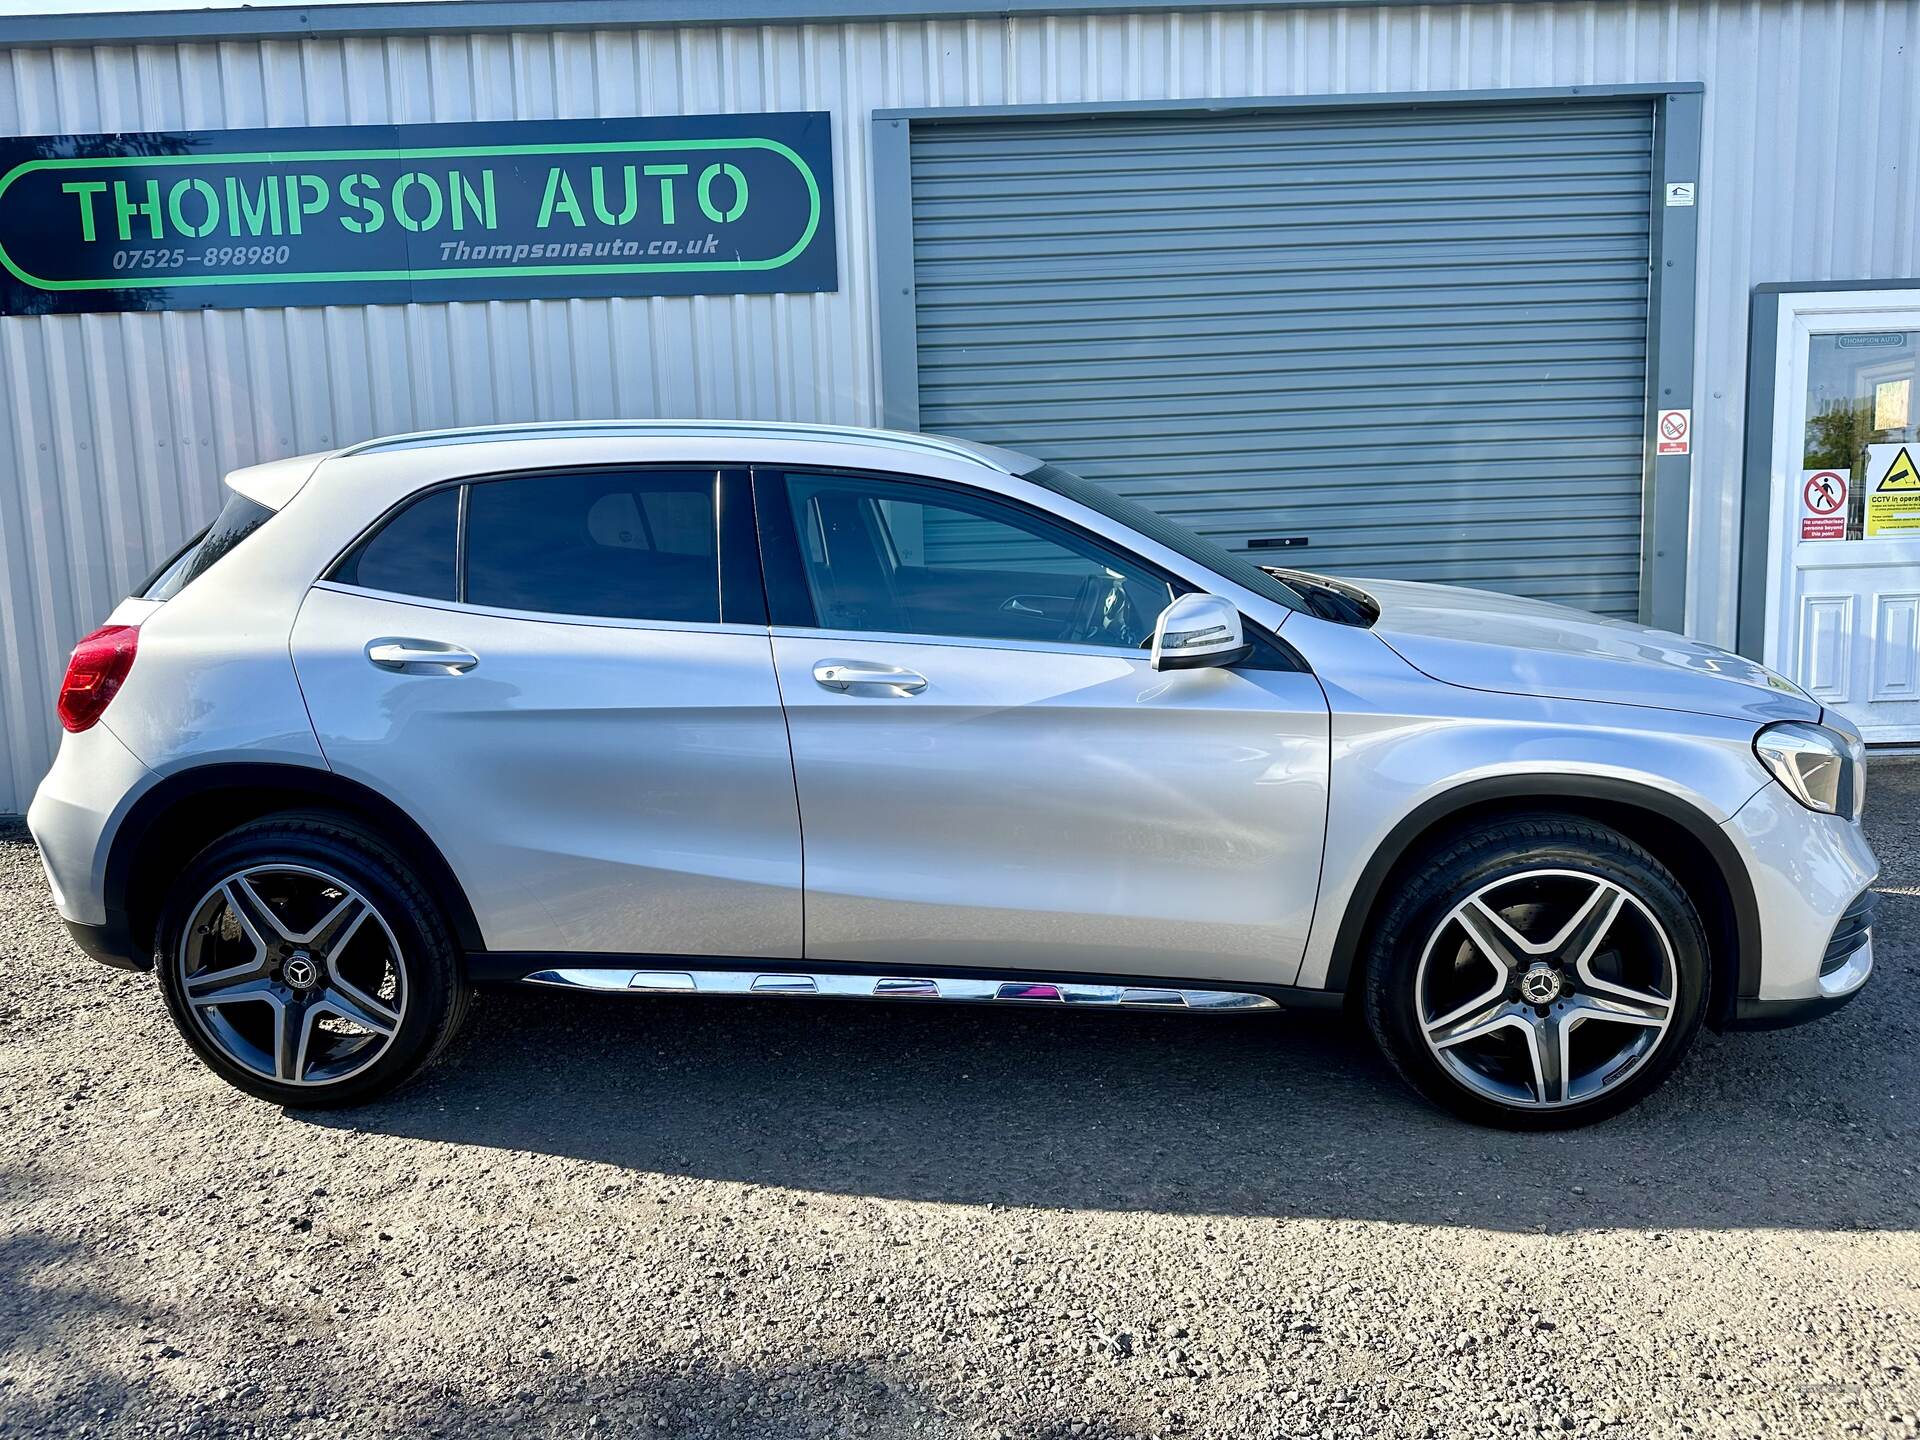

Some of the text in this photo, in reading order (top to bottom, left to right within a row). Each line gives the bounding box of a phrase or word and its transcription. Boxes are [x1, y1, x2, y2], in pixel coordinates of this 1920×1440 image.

[62, 163, 749, 241] THOMPSON AUTO
[112, 245, 290, 270] 07525-898980
[440, 233, 719, 263] Thompsonauto.co.uk
[1843, 335, 1899, 345] THOMPSON AUTO
